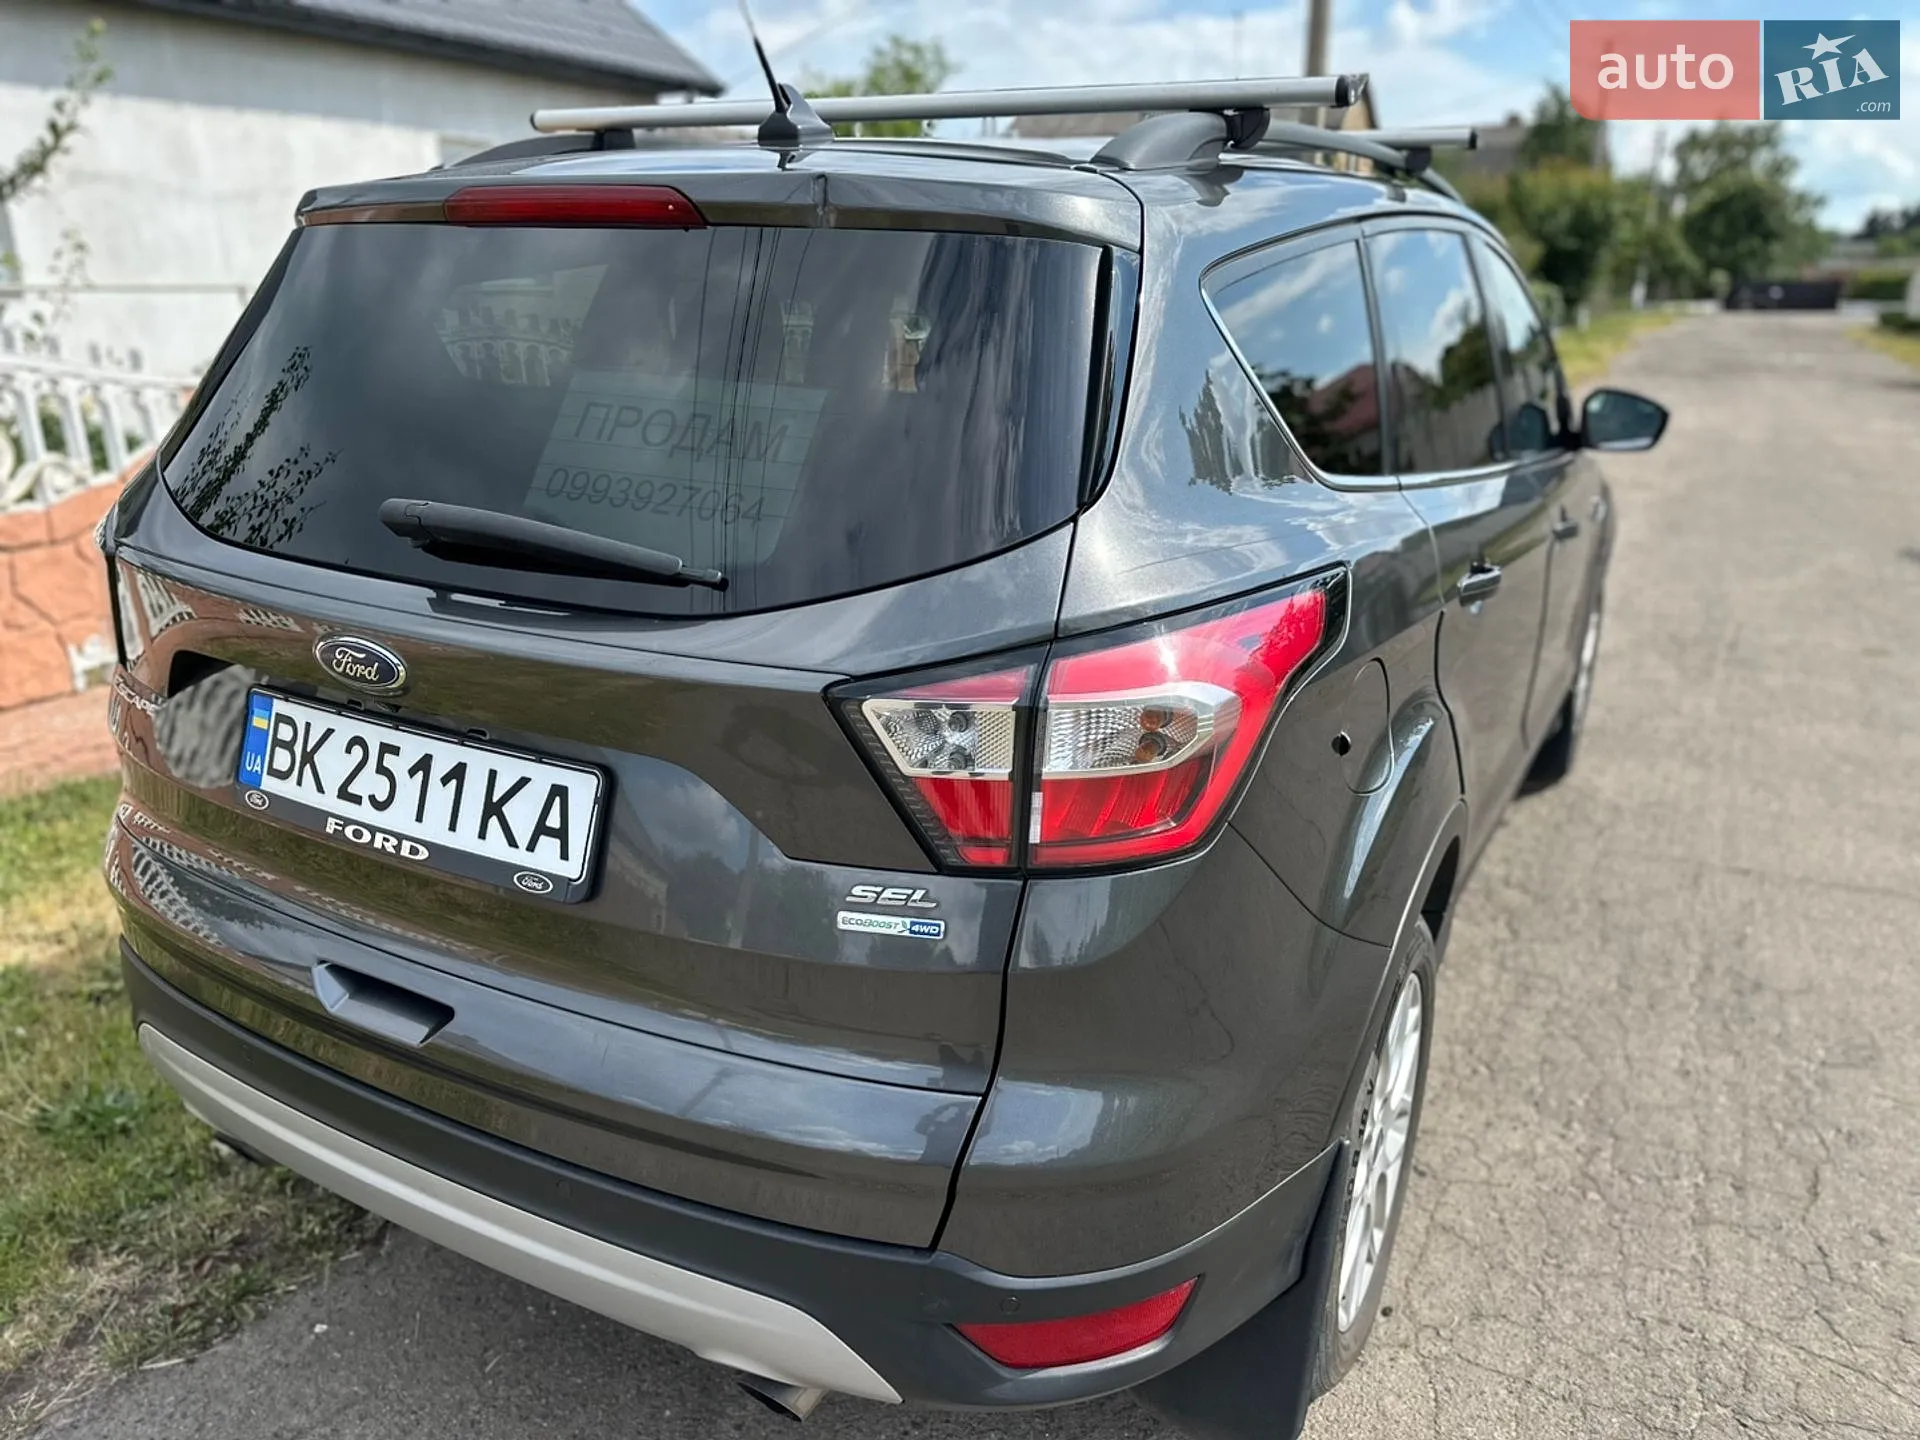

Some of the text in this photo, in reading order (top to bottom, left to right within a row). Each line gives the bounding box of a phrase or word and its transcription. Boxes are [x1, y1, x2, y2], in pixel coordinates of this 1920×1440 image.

[574, 401, 790, 463] ПРОДАМ
[545, 467, 766, 526] 0993927064
[332, 647, 379, 681] Ford
[245, 751, 261, 775] UA
[325, 816, 430, 861] FORD
[845, 884, 938, 909] SEL
[911, 924, 940, 935] 4WD
